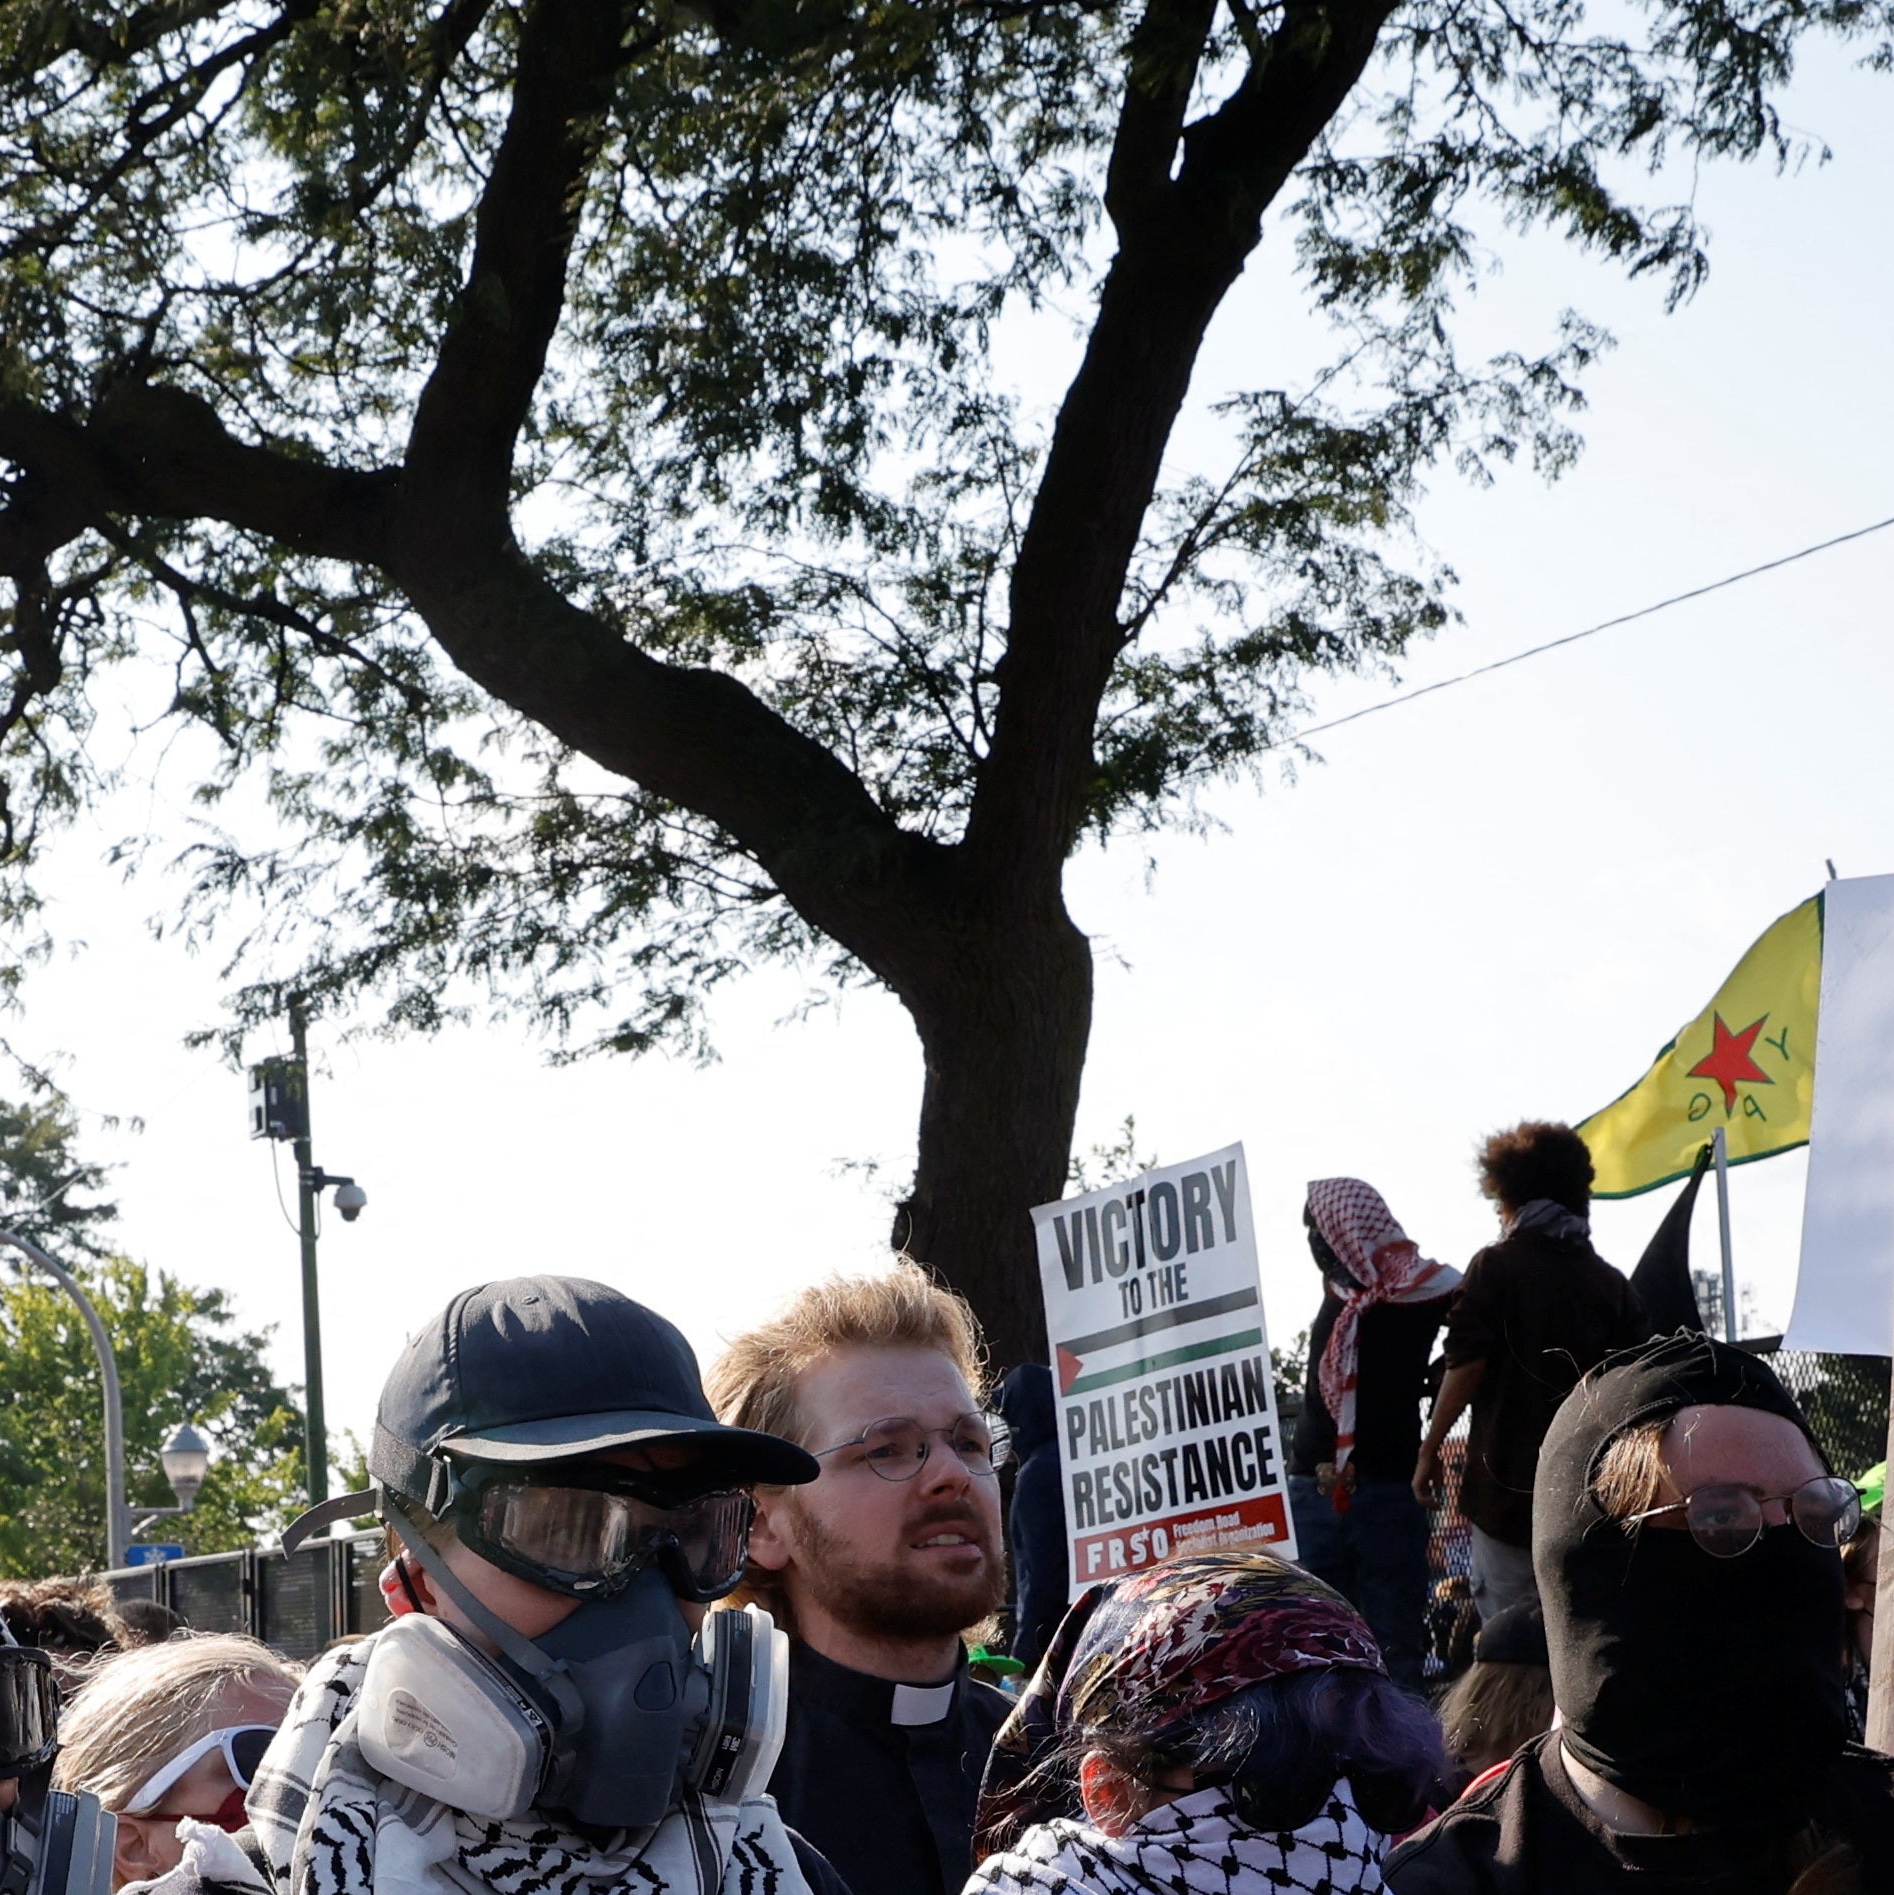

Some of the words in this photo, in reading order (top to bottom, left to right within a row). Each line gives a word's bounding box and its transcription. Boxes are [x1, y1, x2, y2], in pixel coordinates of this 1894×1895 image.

[1053, 1159, 1237, 1292] VICTORY
[1118, 1277, 1142, 1319] TO
[1147, 1262, 1189, 1309] THE
[1066, 1356, 1268, 1460] PALESTINIAN
[1072, 1427, 1277, 1529] RESISTANCE
[1087, 1526, 1169, 1574] FRSO
[1172, 1518, 1215, 1538] Freedom
[1215, 1511, 1241, 1530] Road
